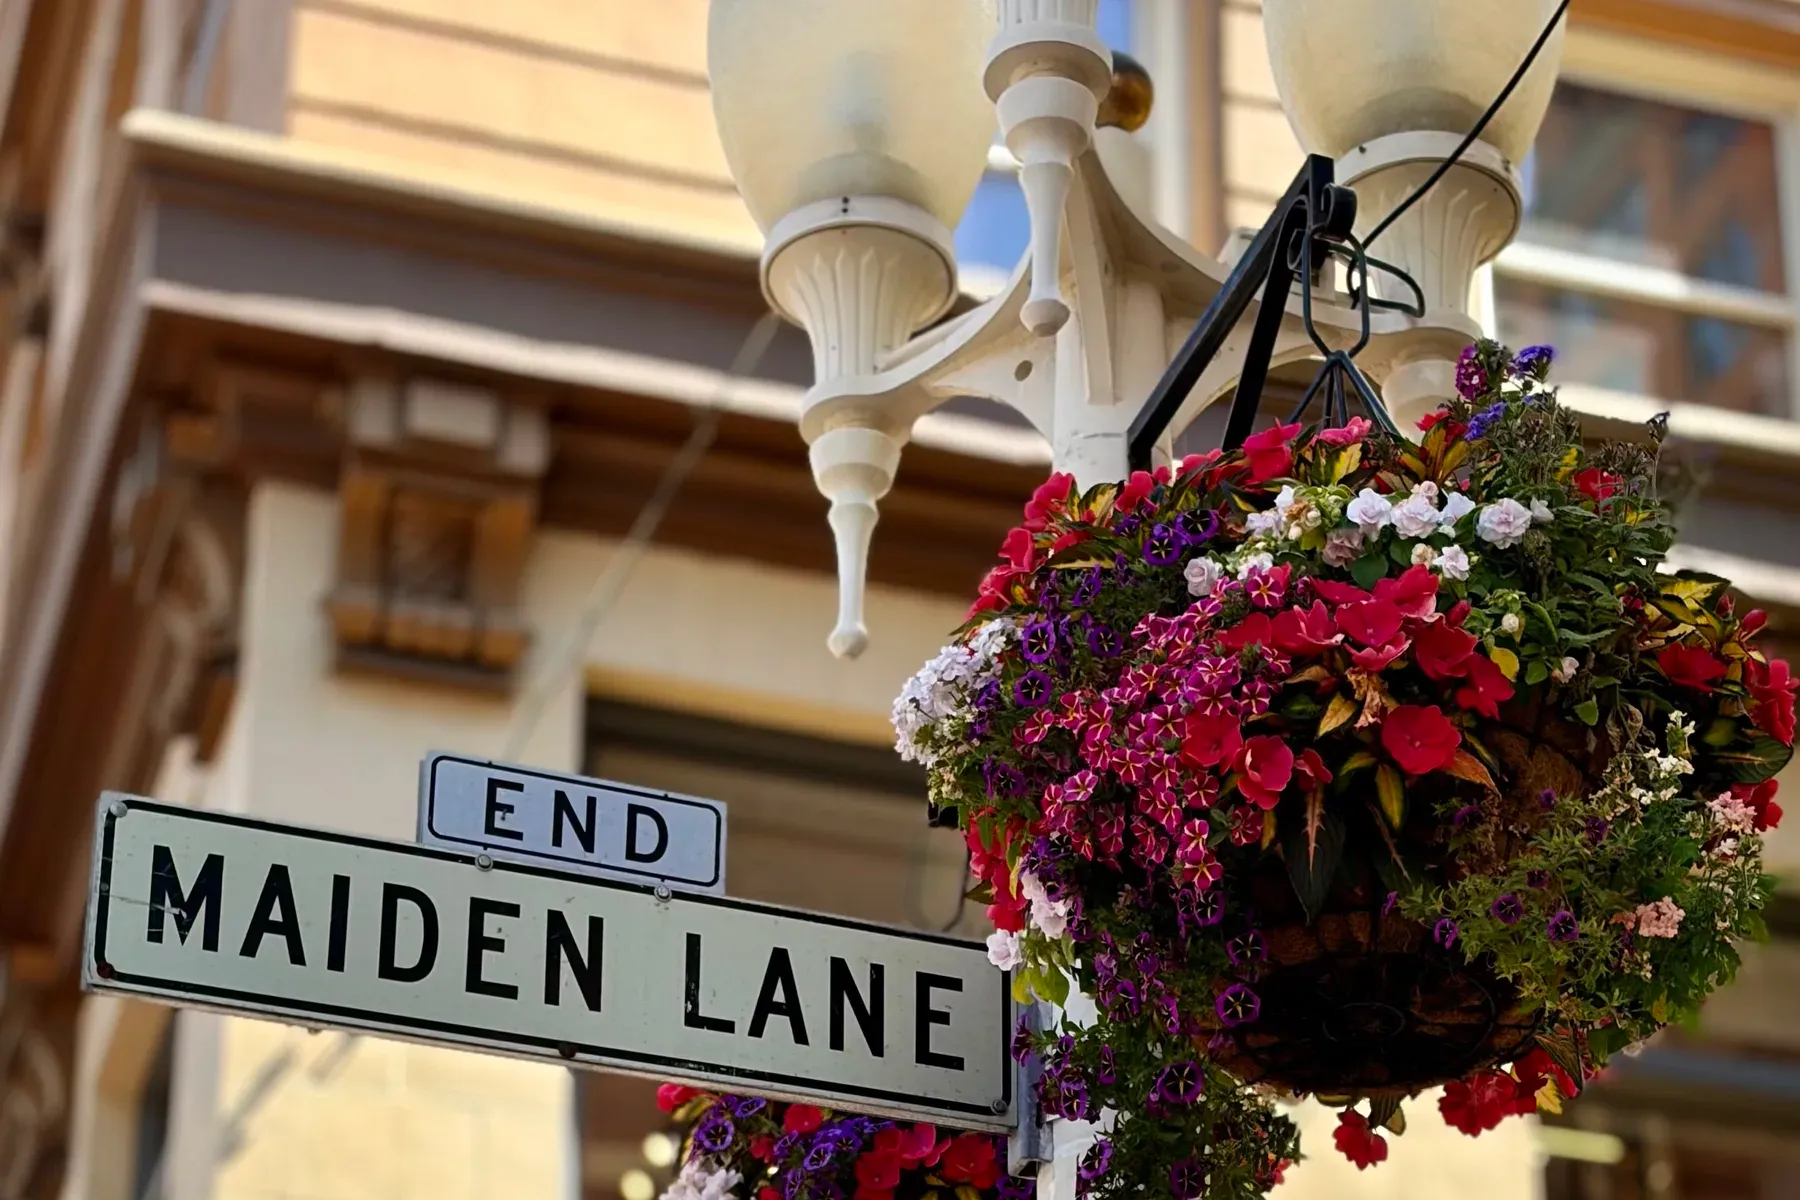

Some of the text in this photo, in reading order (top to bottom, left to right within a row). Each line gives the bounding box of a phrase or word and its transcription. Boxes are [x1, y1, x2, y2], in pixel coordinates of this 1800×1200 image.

[484, 777, 669, 865] END
[148, 844, 965, 1071] MAIDEN LANE
